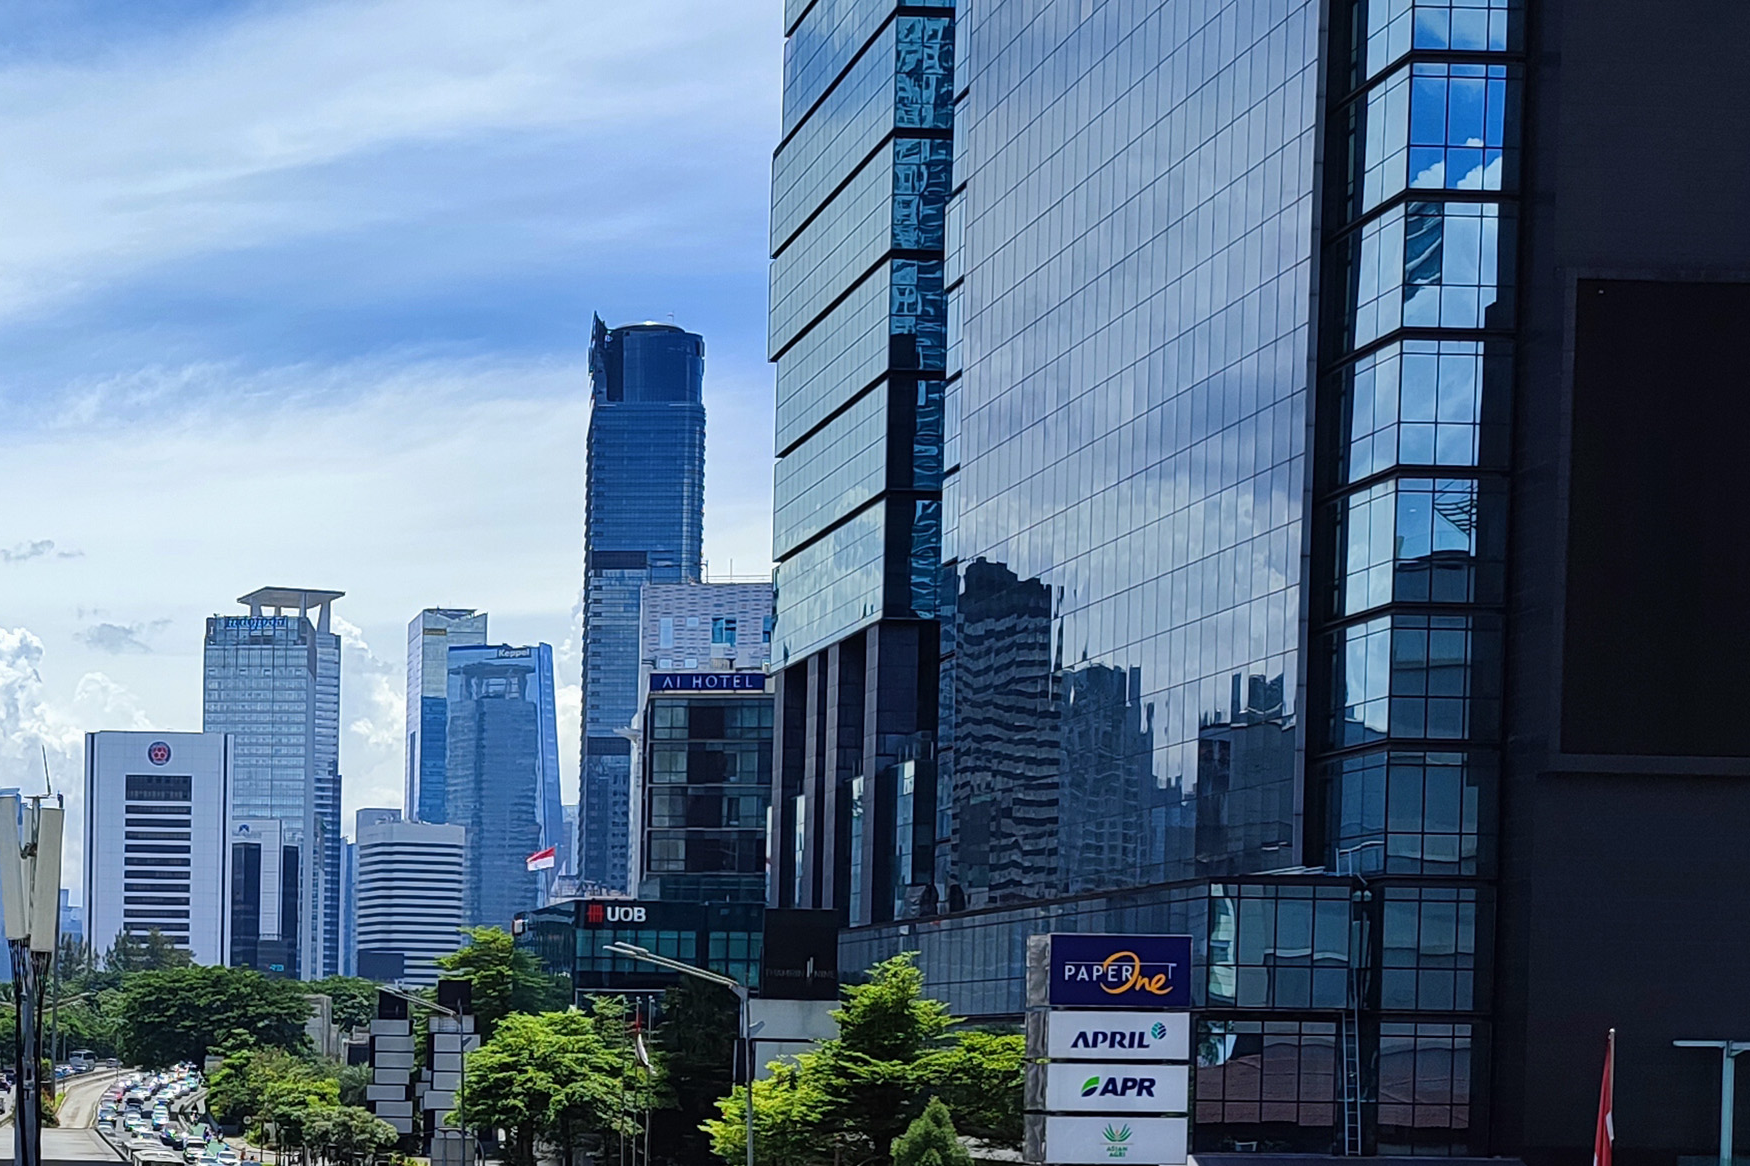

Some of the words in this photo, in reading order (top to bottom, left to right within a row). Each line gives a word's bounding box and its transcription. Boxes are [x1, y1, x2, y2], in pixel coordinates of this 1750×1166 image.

[499, 649, 530, 658] Keppel
[692, 675, 753, 688] HOTEL
[606, 906, 647, 923] UOB
[1064, 965, 1134, 982] PAPER
[1071, 1031, 1150, 1049] APRIL
[1099, 1077, 1156, 1098] APR
